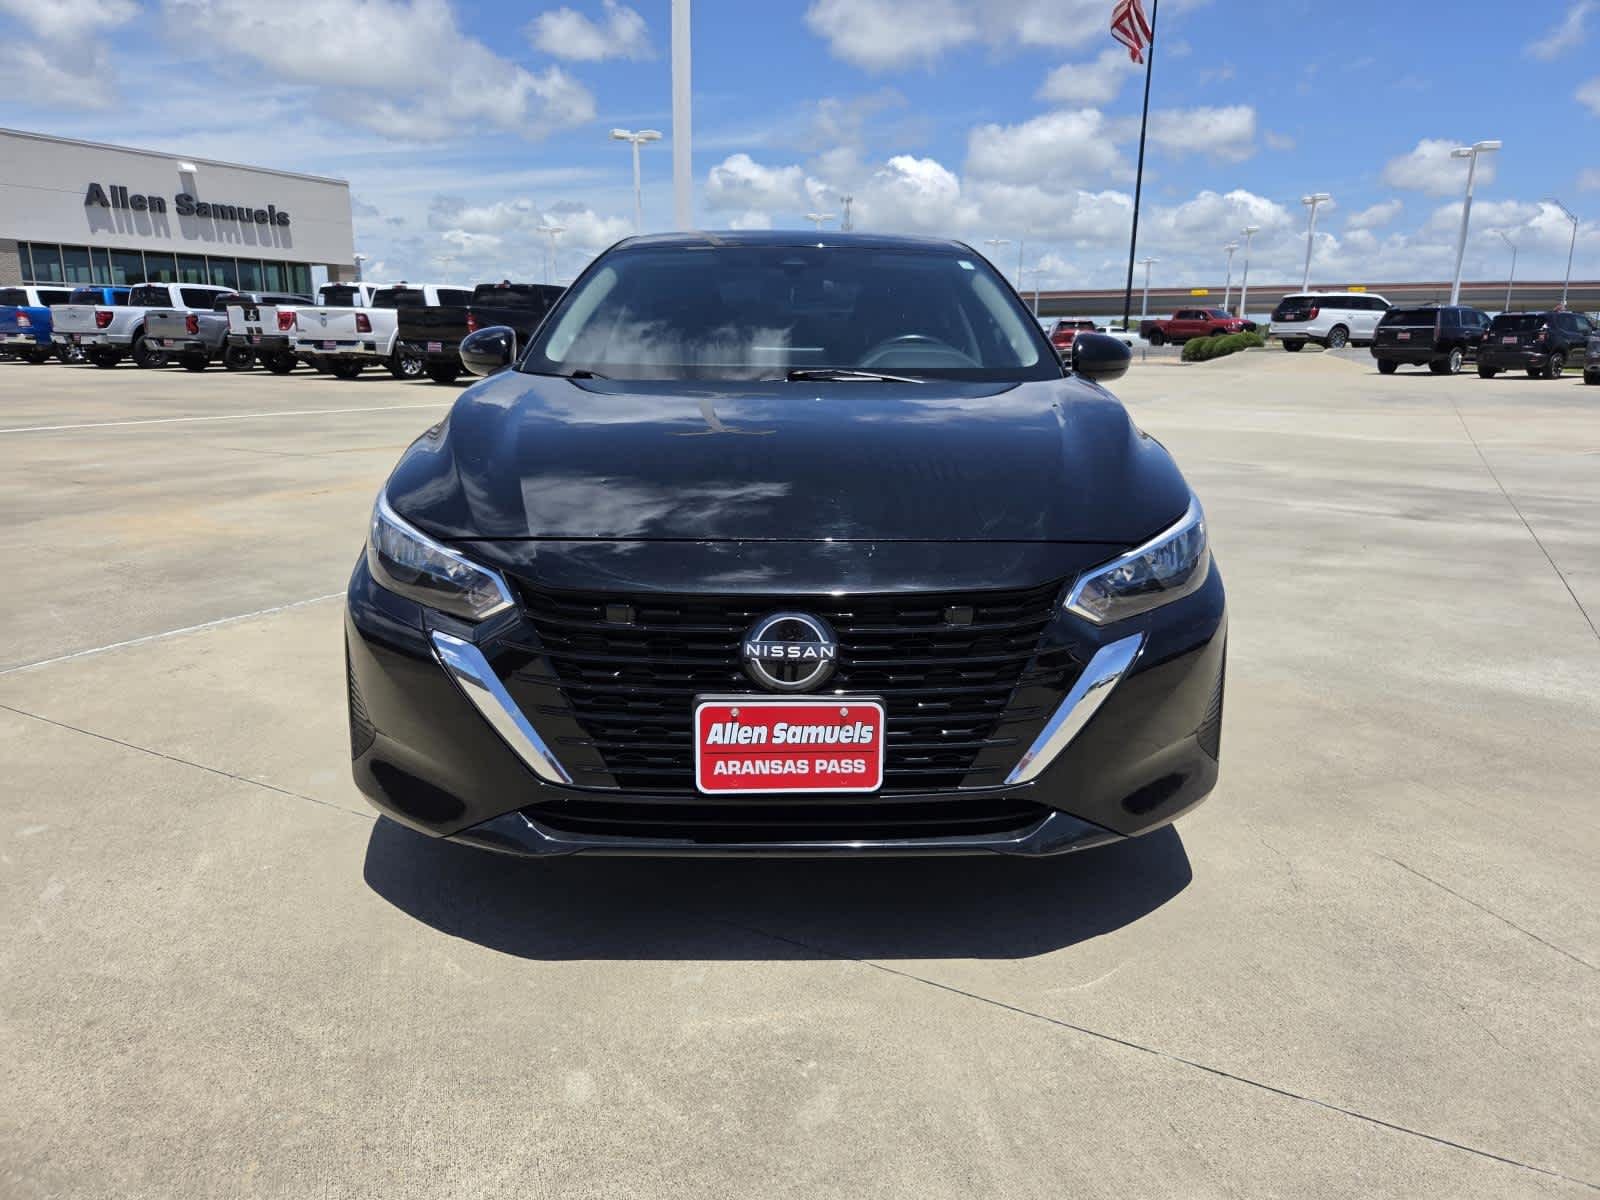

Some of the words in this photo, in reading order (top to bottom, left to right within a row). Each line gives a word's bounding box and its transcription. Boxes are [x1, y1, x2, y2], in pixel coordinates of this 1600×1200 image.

[84, 182, 167, 214] Allen
[175, 192, 290, 227] Samuels
[746, 643, 834, 658] NISSAN
[706, 722, 767, 744] Allen
[772, 722, 873, 743] Samuels
[713, 759, 809, 776] ARANSAS
[815, 758, 866, 774] PASS
